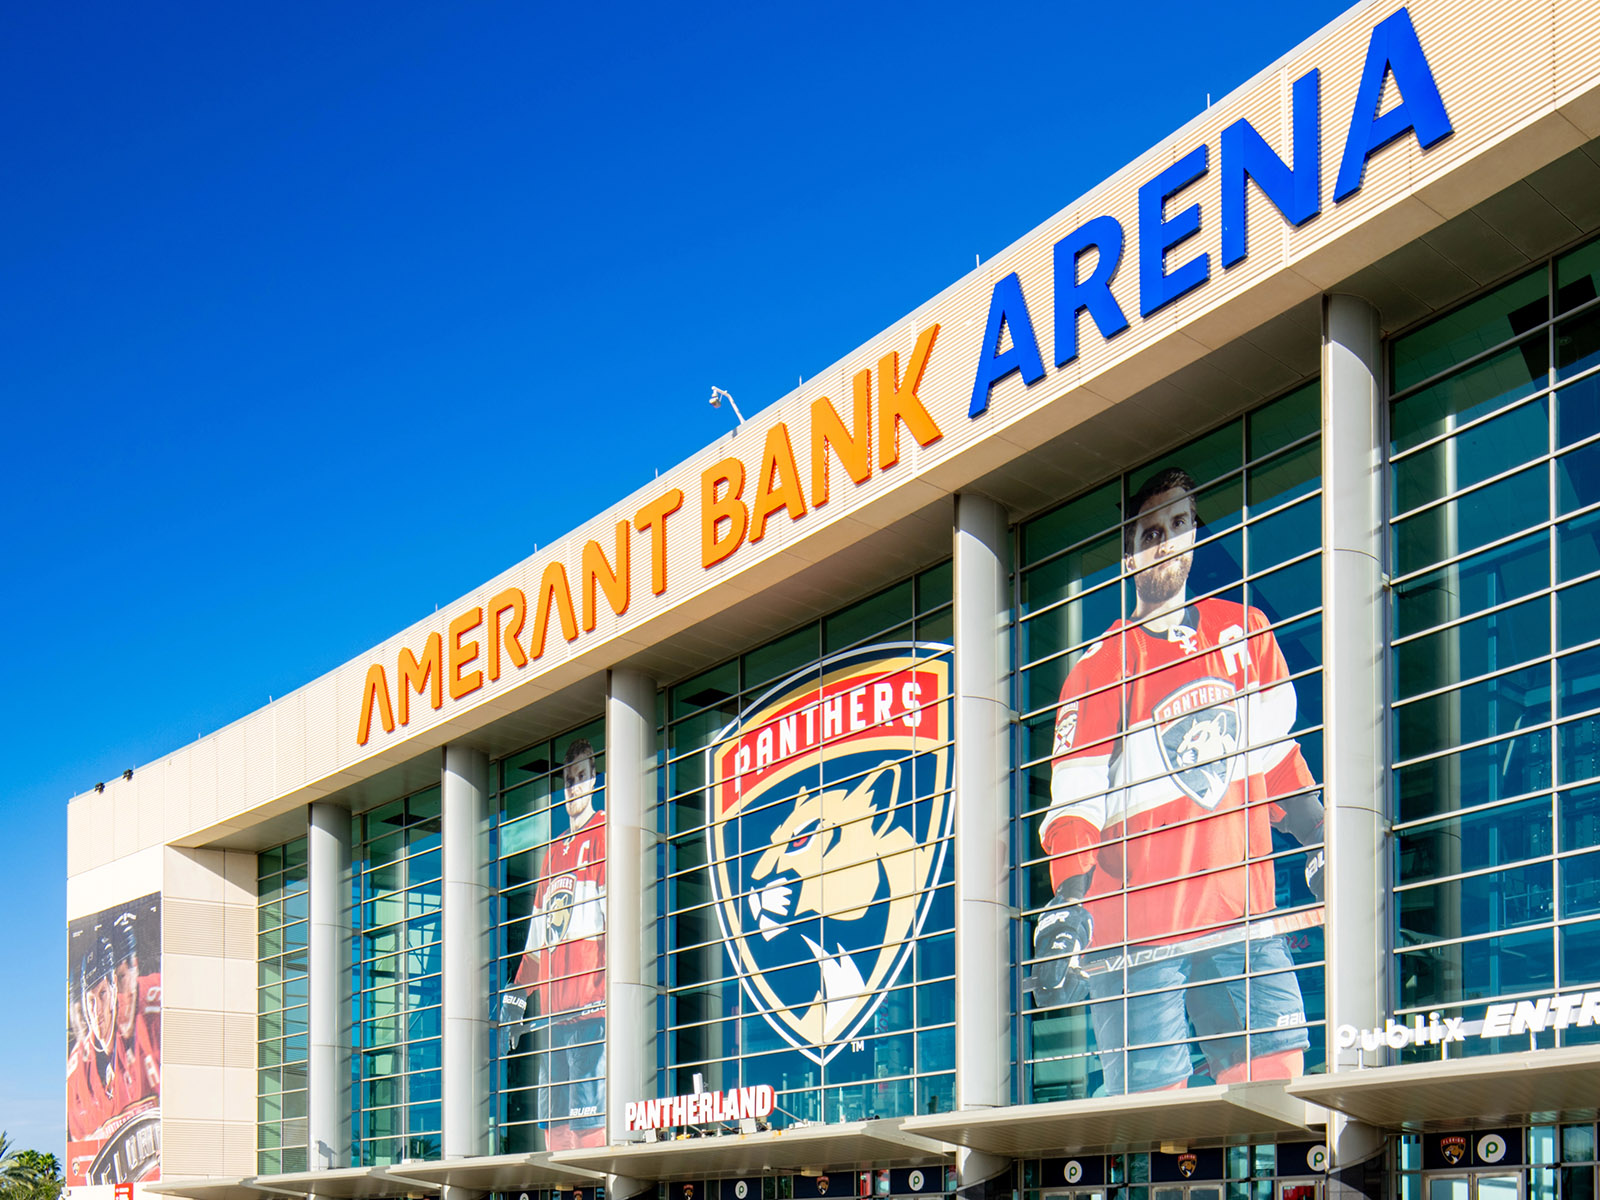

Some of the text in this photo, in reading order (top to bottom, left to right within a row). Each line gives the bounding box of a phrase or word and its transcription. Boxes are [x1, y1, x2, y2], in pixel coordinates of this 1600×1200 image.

[356, 6, 1455, 745] AMERANT BANK ARENA
[733, 681, 923, 795] PANTHERS
[851, 1040, 864, 1053] TM
[624, 1084, 774, 1131] PANTHERLAND
